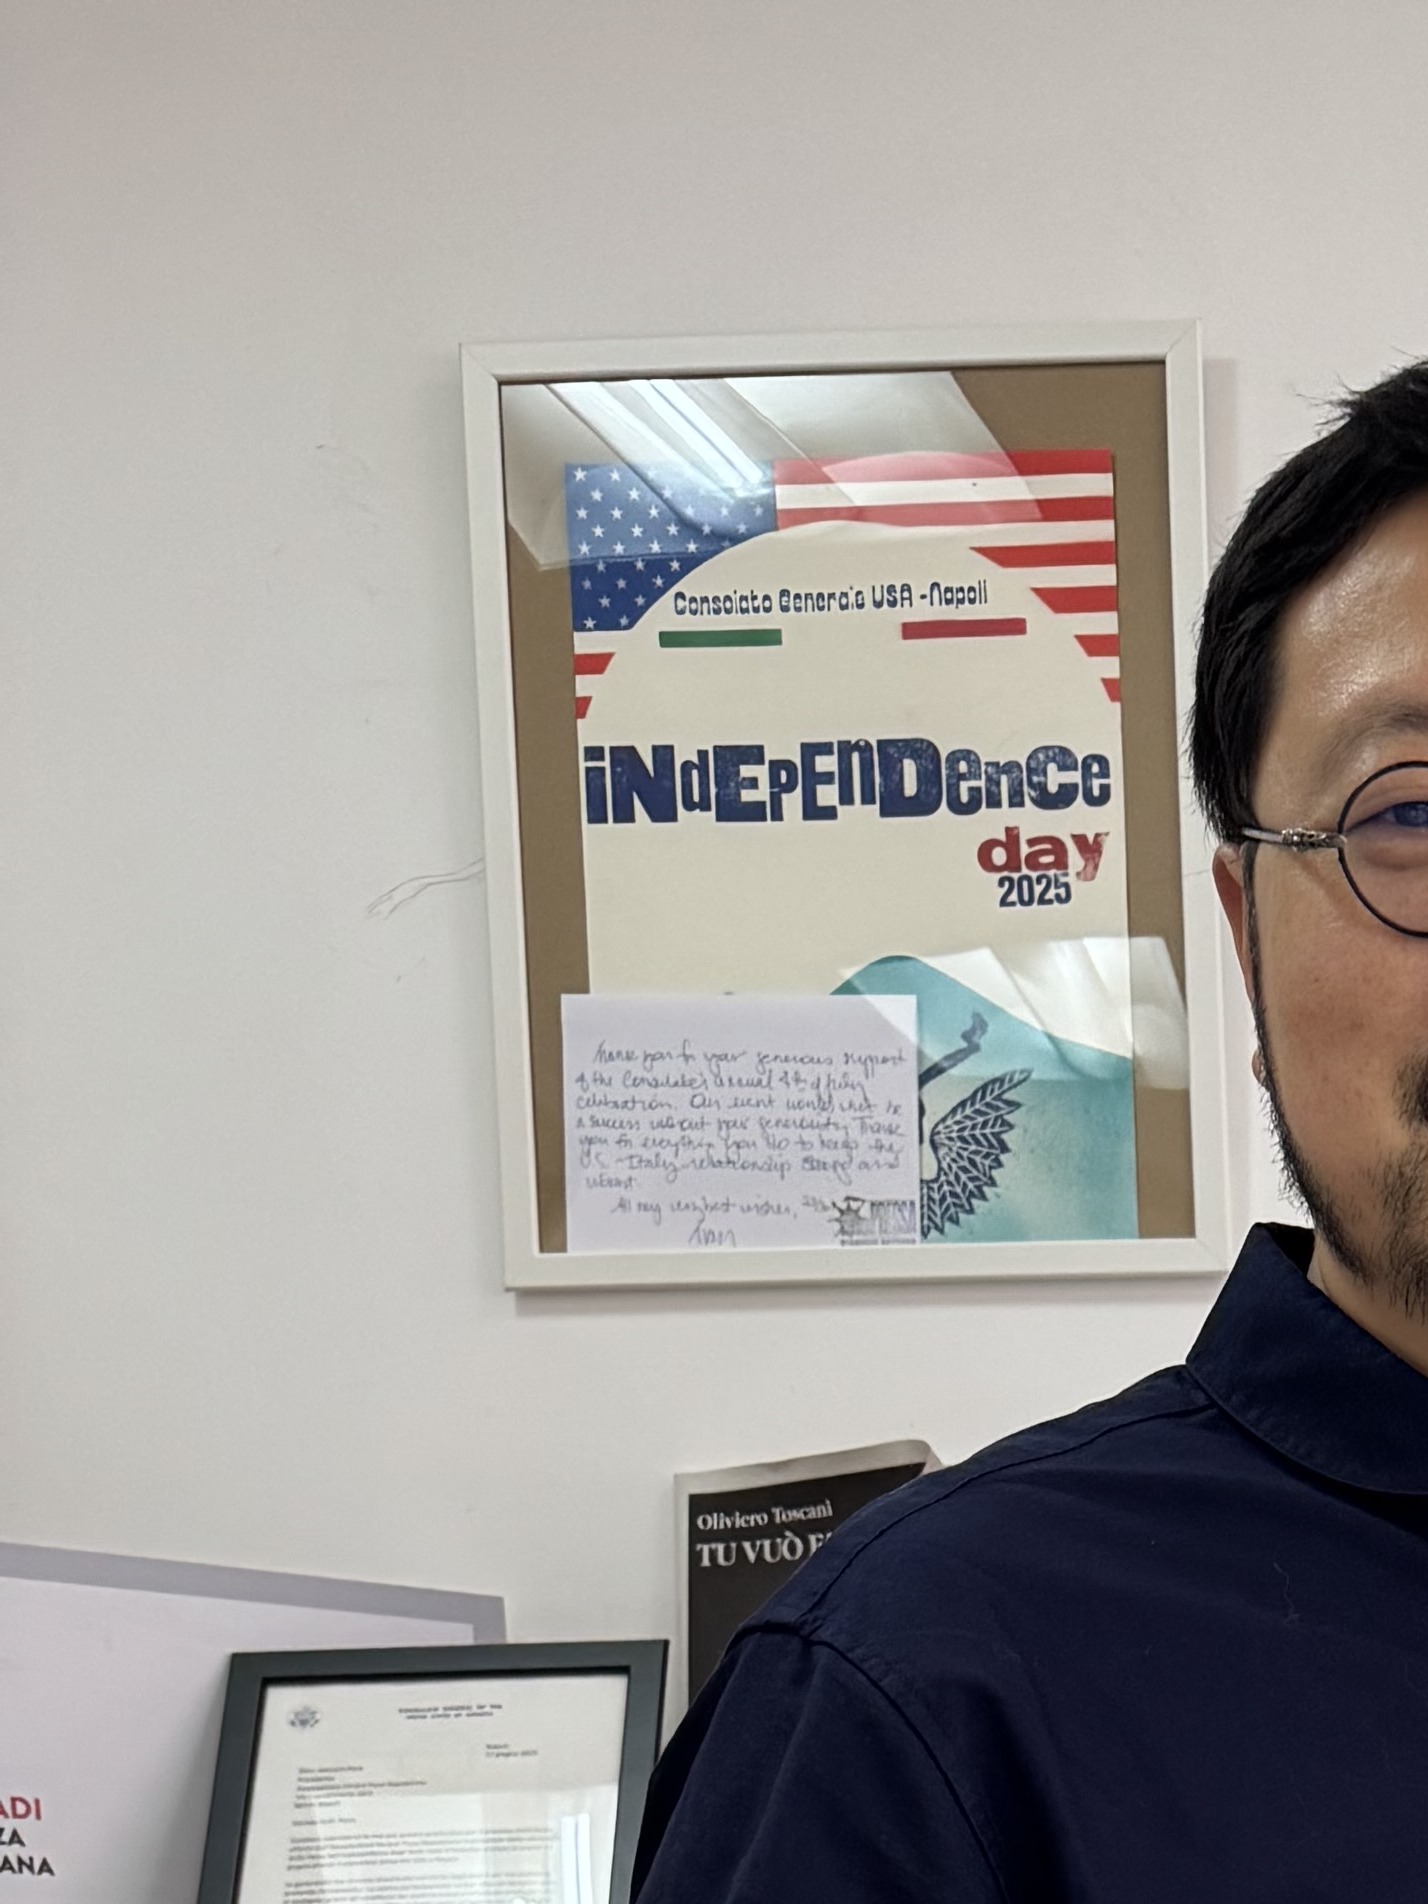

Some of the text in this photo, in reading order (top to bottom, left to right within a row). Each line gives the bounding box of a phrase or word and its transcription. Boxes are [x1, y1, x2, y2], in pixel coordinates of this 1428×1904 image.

[872, 583, 913, 609] USA
[976, 826, 1110, 882] day
[998, 872, 1072, 908] 2025
[697, 1499, 834, 1531] Oliviero Toscani
[696, 1530, 804, 1567] TU VUÒ
